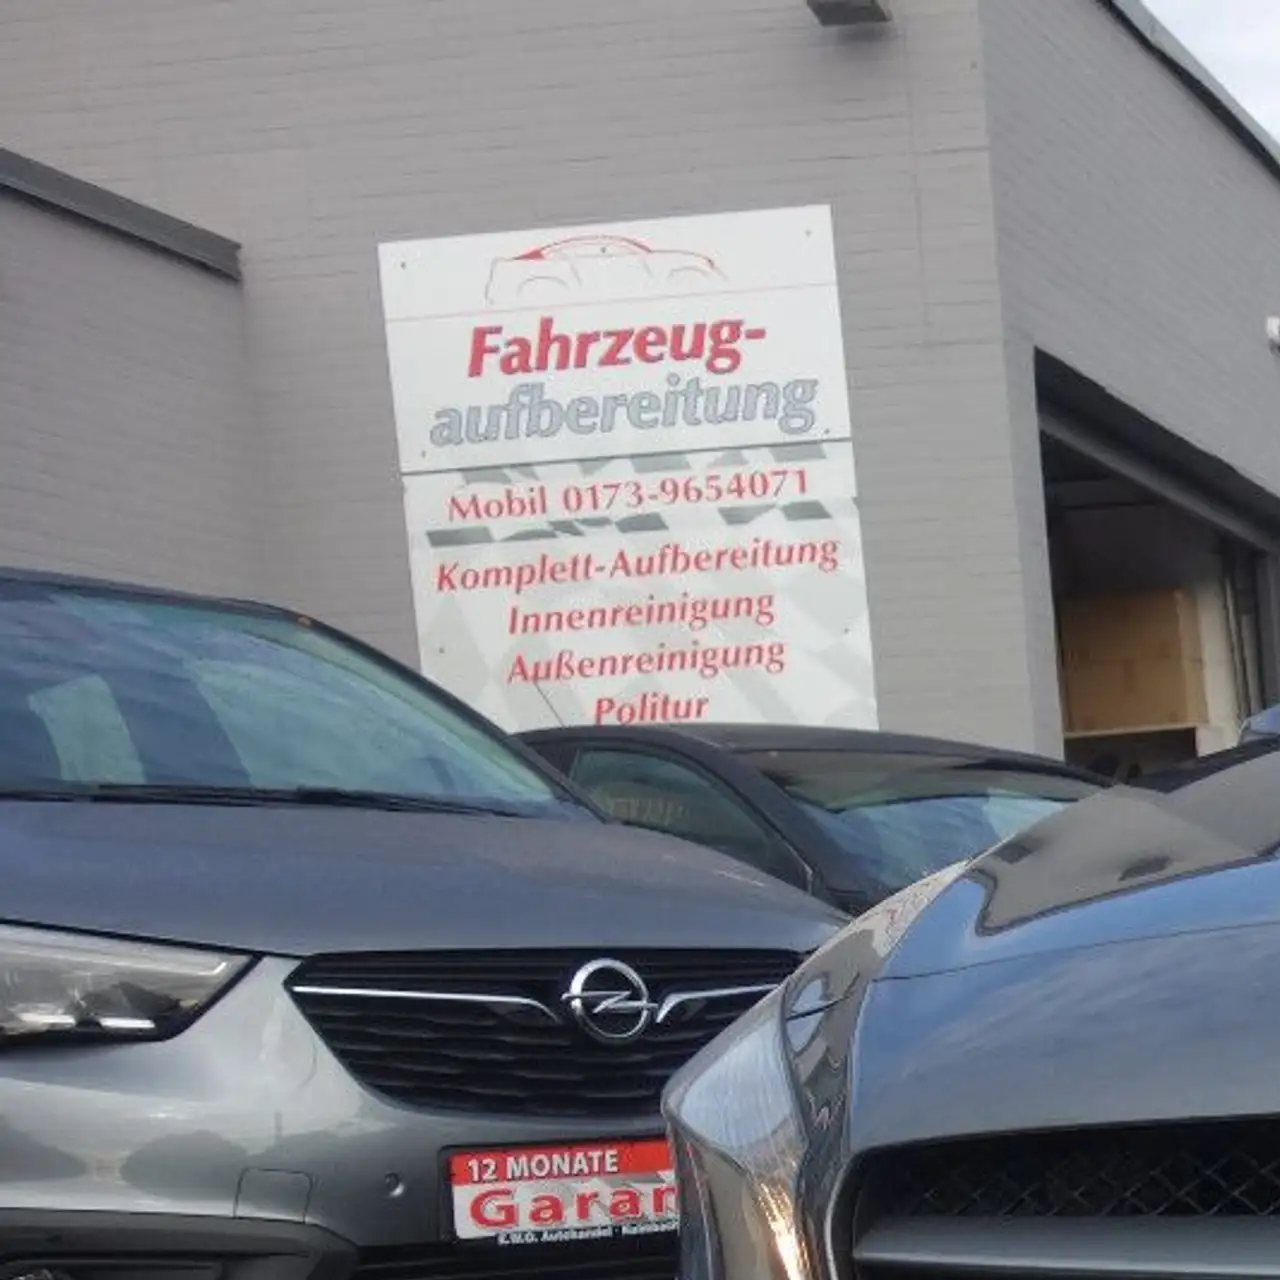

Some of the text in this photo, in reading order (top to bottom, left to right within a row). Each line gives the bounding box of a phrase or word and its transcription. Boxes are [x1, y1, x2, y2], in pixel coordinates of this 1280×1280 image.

[467, 317, 766, 378] Fahrzeug-
[429, 373, 819, 448] aufbereitung
[447, 468, 808, 522] Mobil 0173-9654071
[436, 538, 839, 595] Komplett-Aufbereitung
[508, 591, 775, 636] Innenreinigung
[507, 640, 785, 685] Außenreinigung
[594, 695, 709, 726] Politur
[468, 1150, 618, 1182] 12 MONATE
